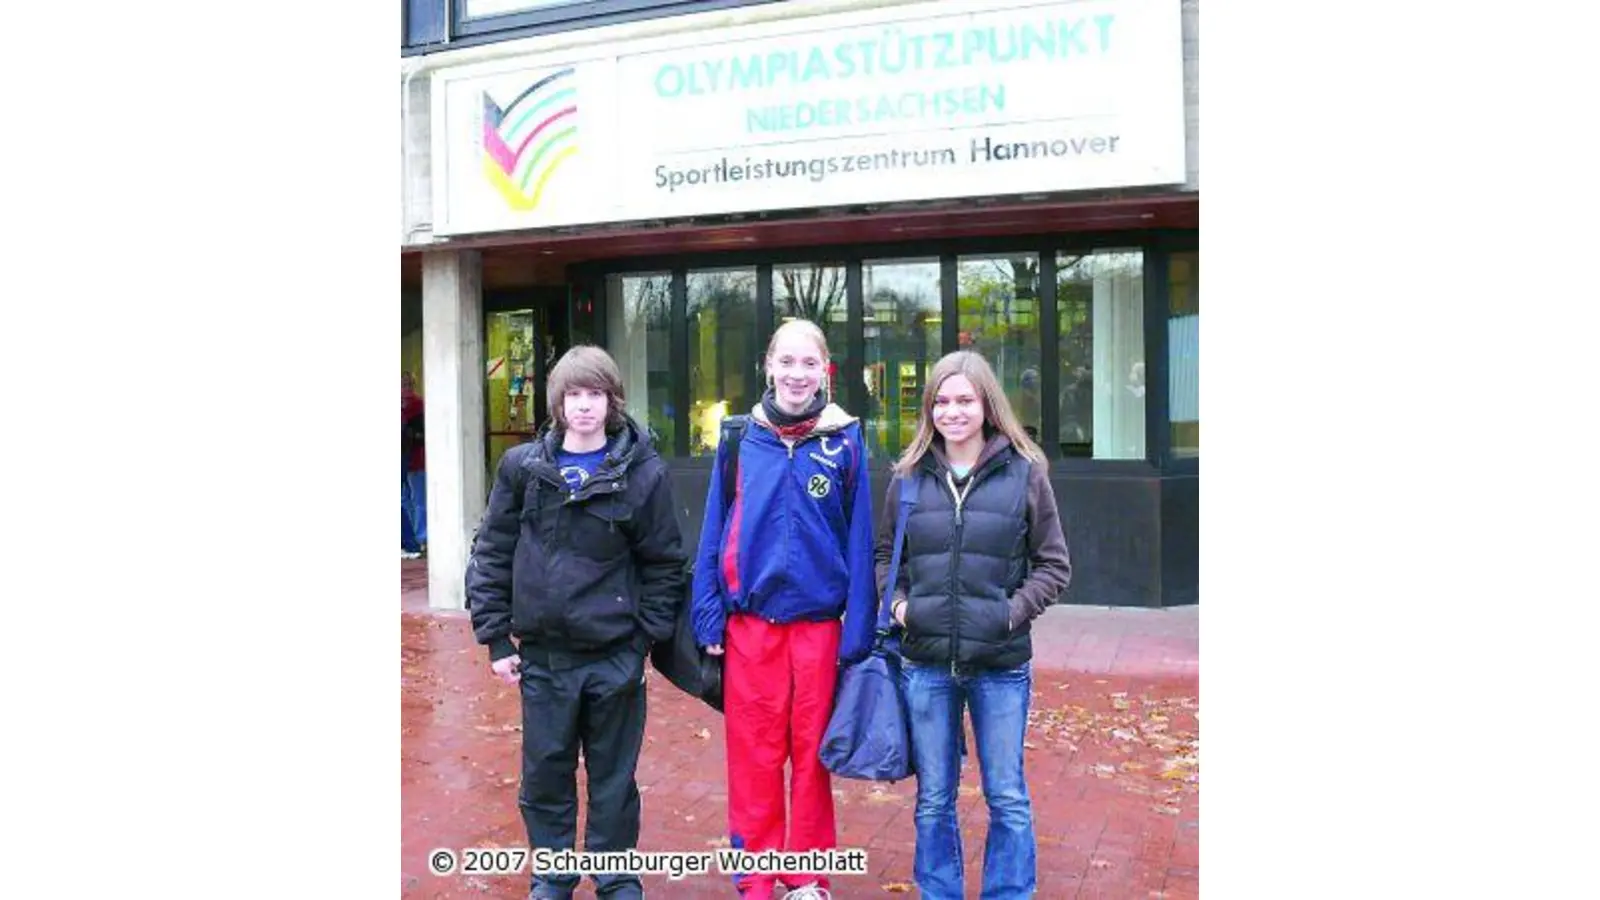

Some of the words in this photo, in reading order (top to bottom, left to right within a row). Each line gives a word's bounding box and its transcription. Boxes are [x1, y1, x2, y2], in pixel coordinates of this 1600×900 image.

[654, 13, 1115, 100] OLYMPIASTÜTZPUNKT
[745, 83, 1006, 134] NIEDERSACHSEN
[654, 145, 957, 192] Sportleistungszentrum
[969, 133, 1120, 164] Hannover
[810, 476, 828, 496] 96
